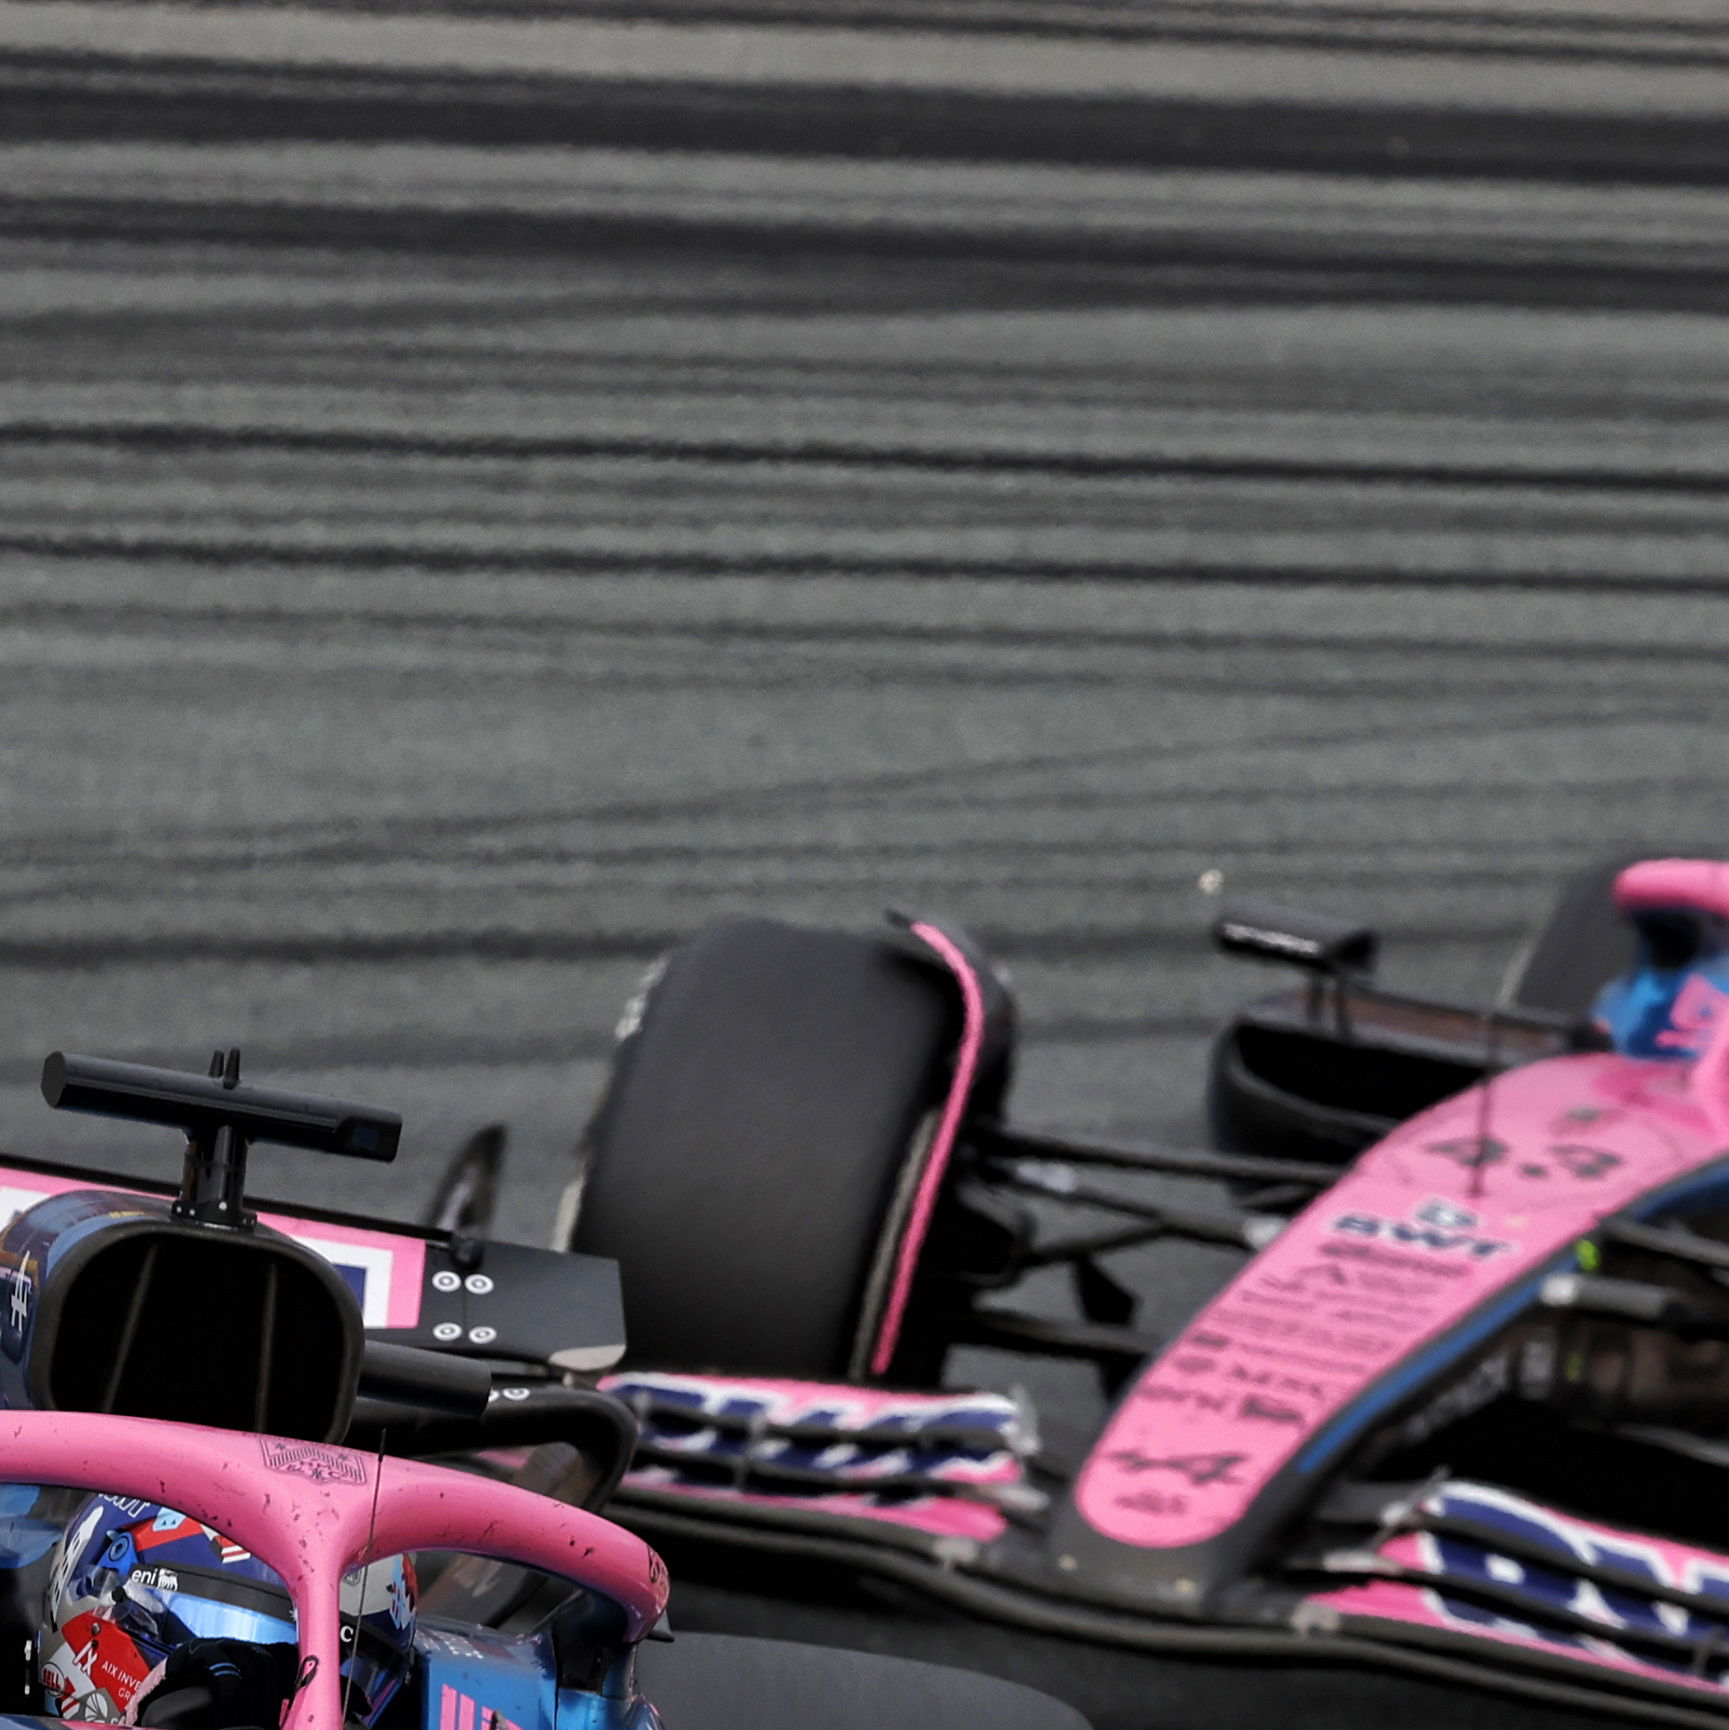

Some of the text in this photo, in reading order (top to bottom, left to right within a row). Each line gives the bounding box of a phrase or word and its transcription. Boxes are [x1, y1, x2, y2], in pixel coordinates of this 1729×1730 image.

[131, 1568, 158, 1585] eni
[101, 1660, 142, 1691] AIX INVE
